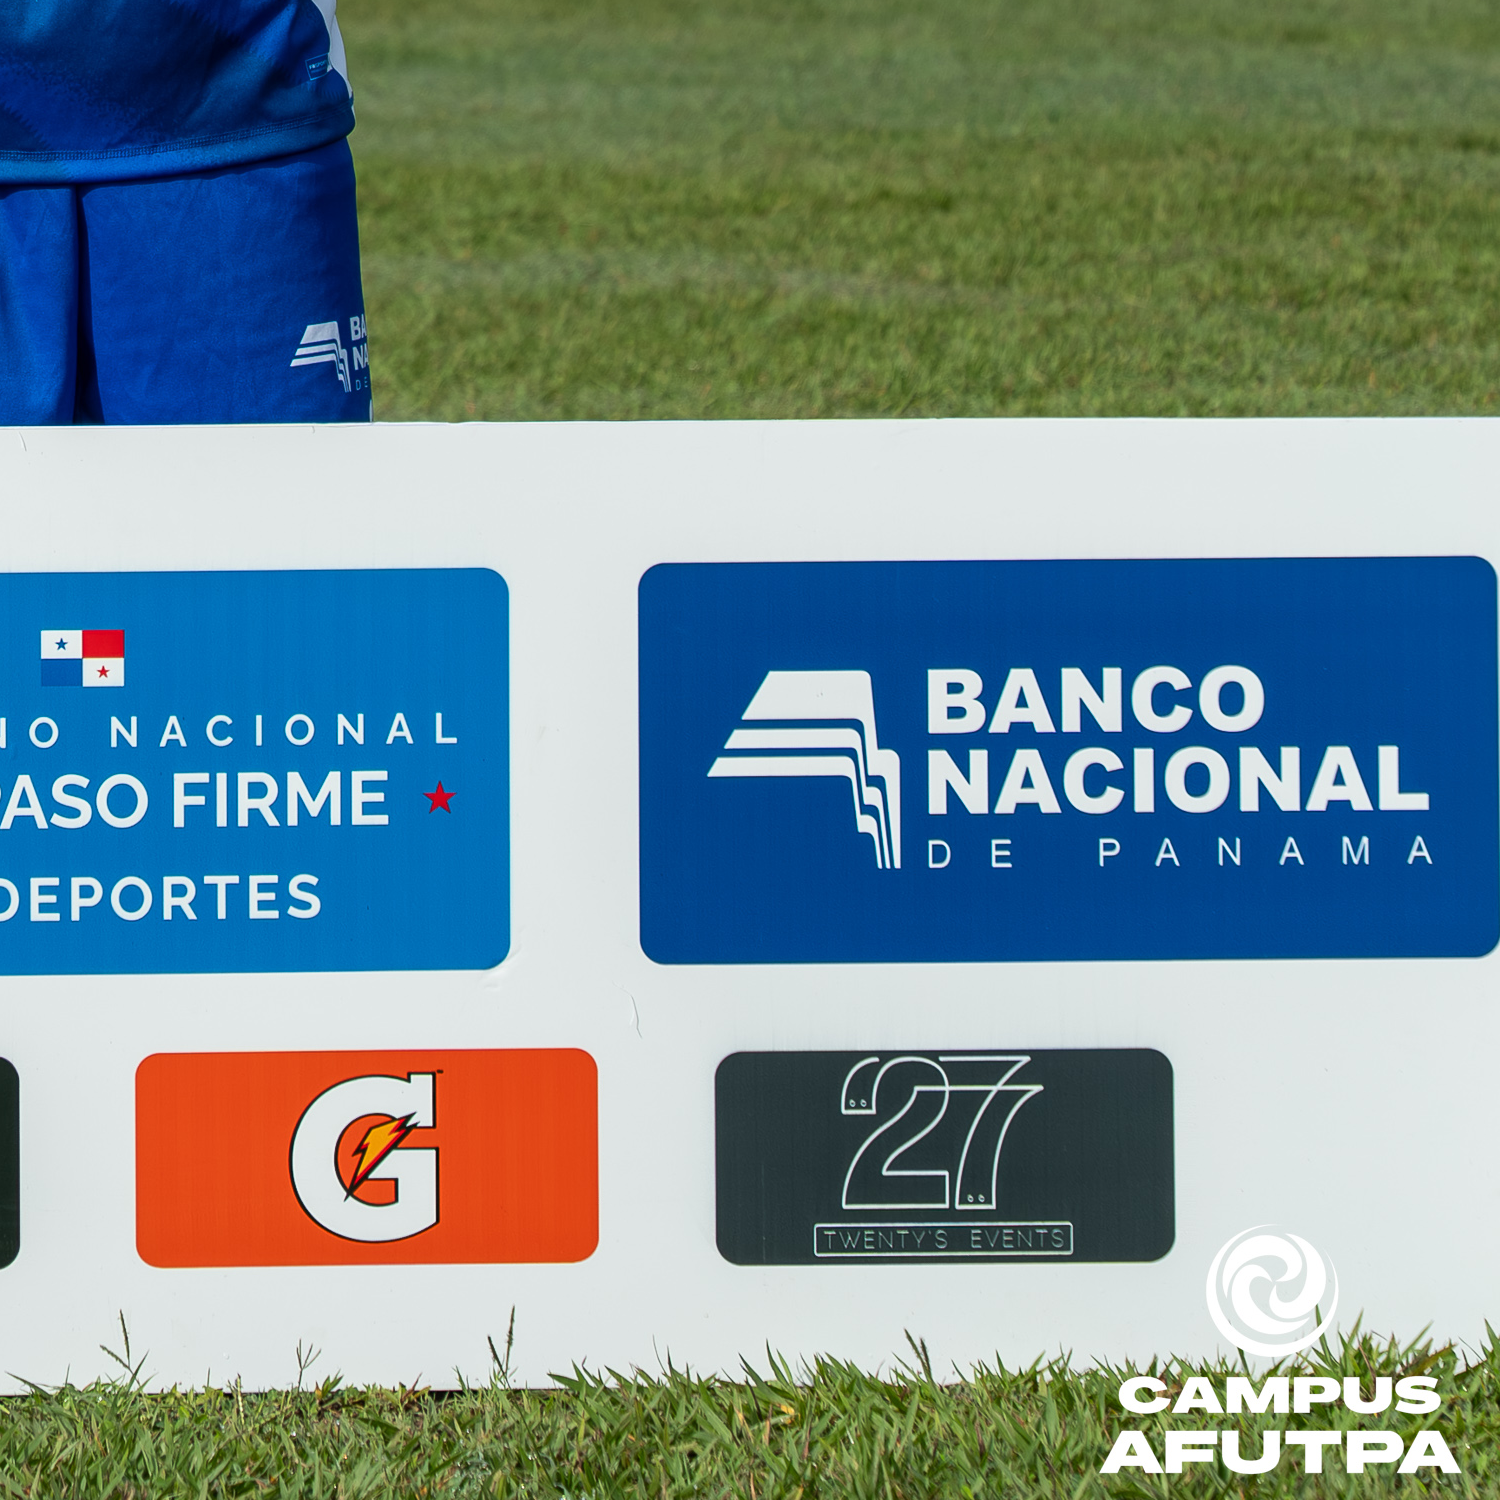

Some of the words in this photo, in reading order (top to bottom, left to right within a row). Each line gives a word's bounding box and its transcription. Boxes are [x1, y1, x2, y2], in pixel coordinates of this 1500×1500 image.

[927, 665, 1265, 735] BANCO
[109, 712, 458, 748] NACIONAL
[172, 770, 390, 828] FIRME
[927, 745, 1430, 815] NACIONAL
[928, 839, 1013, 869] DE
[1099, 835, 1434, 868] PANAMA
[288, 1071, 440, 1244] G
[823, 1229, 949, 1250] TWENTY'S
[970, 1228, 1065, 1249] EVENTS
